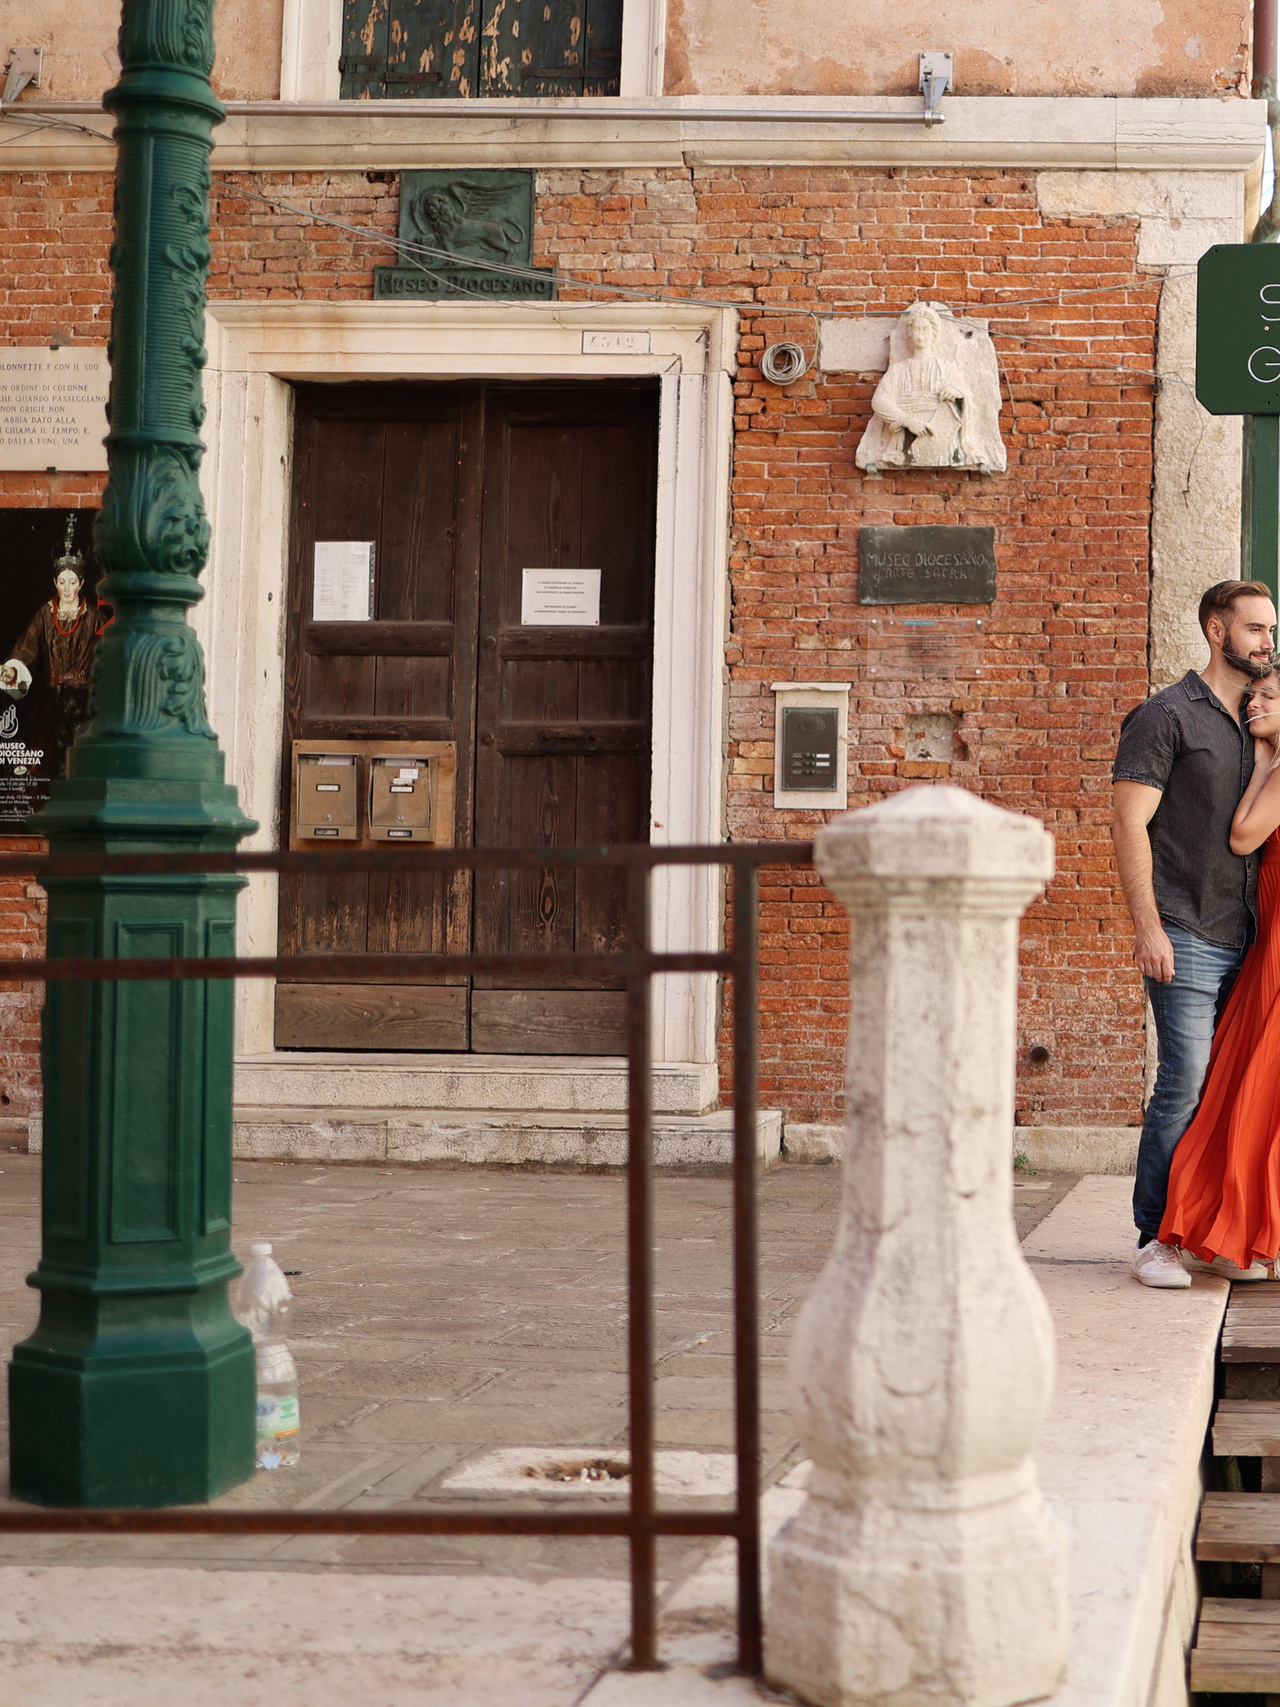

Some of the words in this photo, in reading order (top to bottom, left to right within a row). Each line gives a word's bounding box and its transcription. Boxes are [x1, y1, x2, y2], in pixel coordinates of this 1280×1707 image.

[0, 363, 43, 371] LONNETTE
[46, 363, 51, 371] E
[54, 363, 69, 371] CON
[73, 363, 80, 371] IL
[84, 363, 99, 371] SUO
[52, 384, 88, 392] COLONNE
[0, 405, 16, 413] NON
[48, 405, 65, 413] NON
[4, 416, 28, 424] ABBIA
[31, 416, 52, 424] DATO
[55, 416, 76, 424] ALLA
[5, 426, 37, 434] CHIAMA
[40, 426, 47, 434] IL
[7, 437, 34, 445] DALLA
[62, 437, 79, 445] UNA
[0, 742, 26, 750] MUSEO
